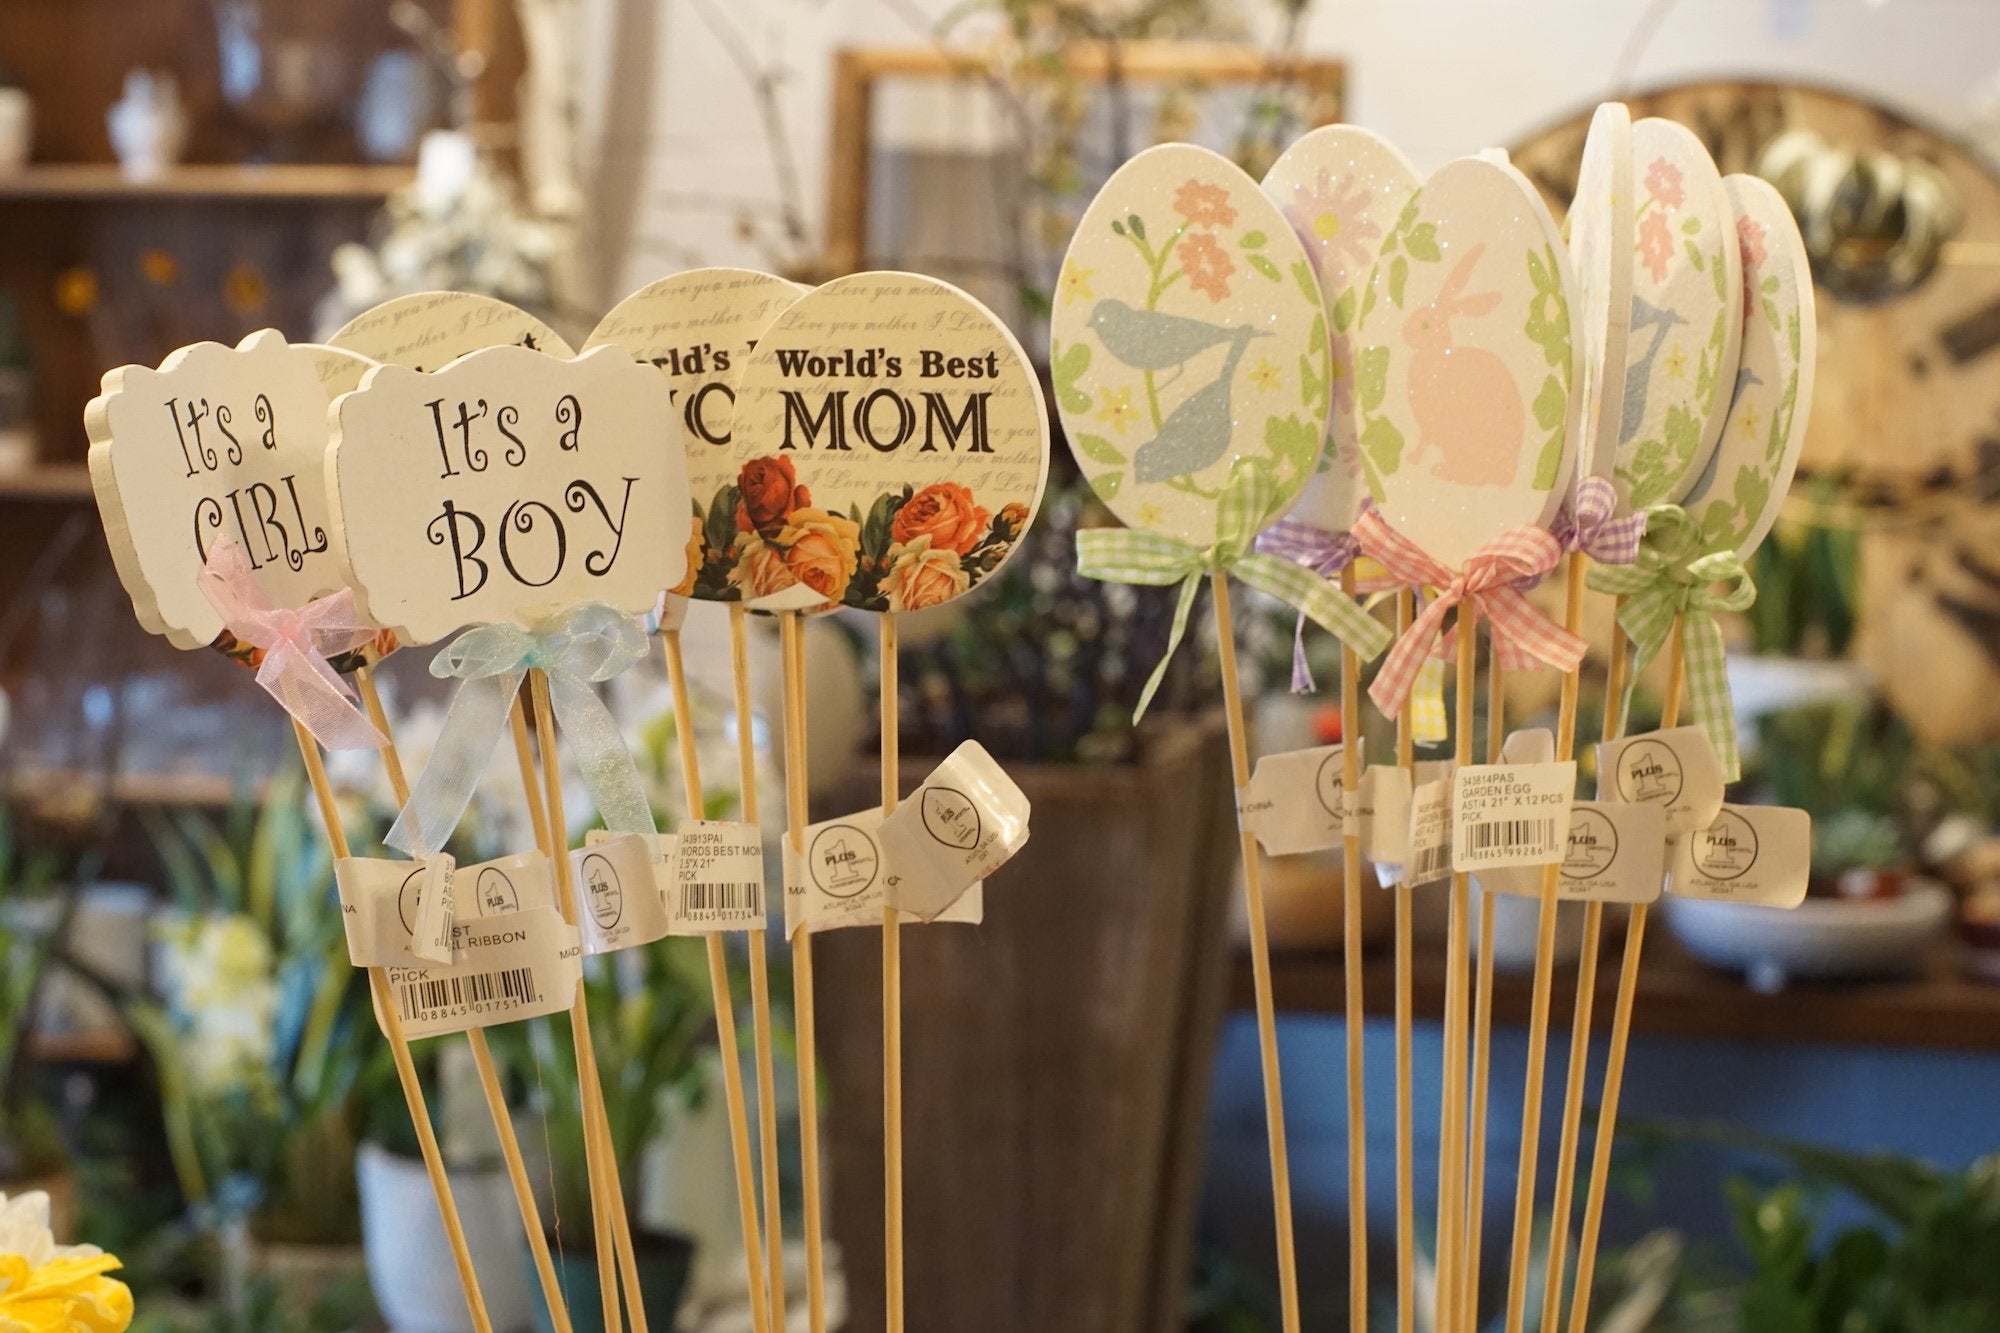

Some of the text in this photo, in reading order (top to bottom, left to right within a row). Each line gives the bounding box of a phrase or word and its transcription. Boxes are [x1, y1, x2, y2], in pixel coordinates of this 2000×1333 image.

[775, 347, 902, 378] World's
[920, 350, 999, 379] Best
[778, 388, 995, 453] MOM
[164, 393, 278, 478] It's a
[424, 394, 582, 479] It's a
[426, 476, 641, 601] BOY
[1632, 764, 1663, 779] PLUS
[1462, 783, 1531, 799] GARDEN EGG
[1514, 796, 1522, 806] X
[1526, 796, 1538, 806] 12
[1541, 793, 1563, 805] PCS
[1461, 811, 1482, 823] PICK
[1706, 835, 1737, 847] PLUS
[713, 846, 740, 856] BEST
[825, 850, 857, 866] PLUS
[678, 870, 697, 881] PICK
[687, 910, 716, 921] 08845
[721, 910, 752, 921] 01734
[468, 930, 527, 949] RIBBON
[390, 969, 429, 985] PICK
[420, 1005, 467, 1022] 08845
[475, 998, 519, 1014] 01751
